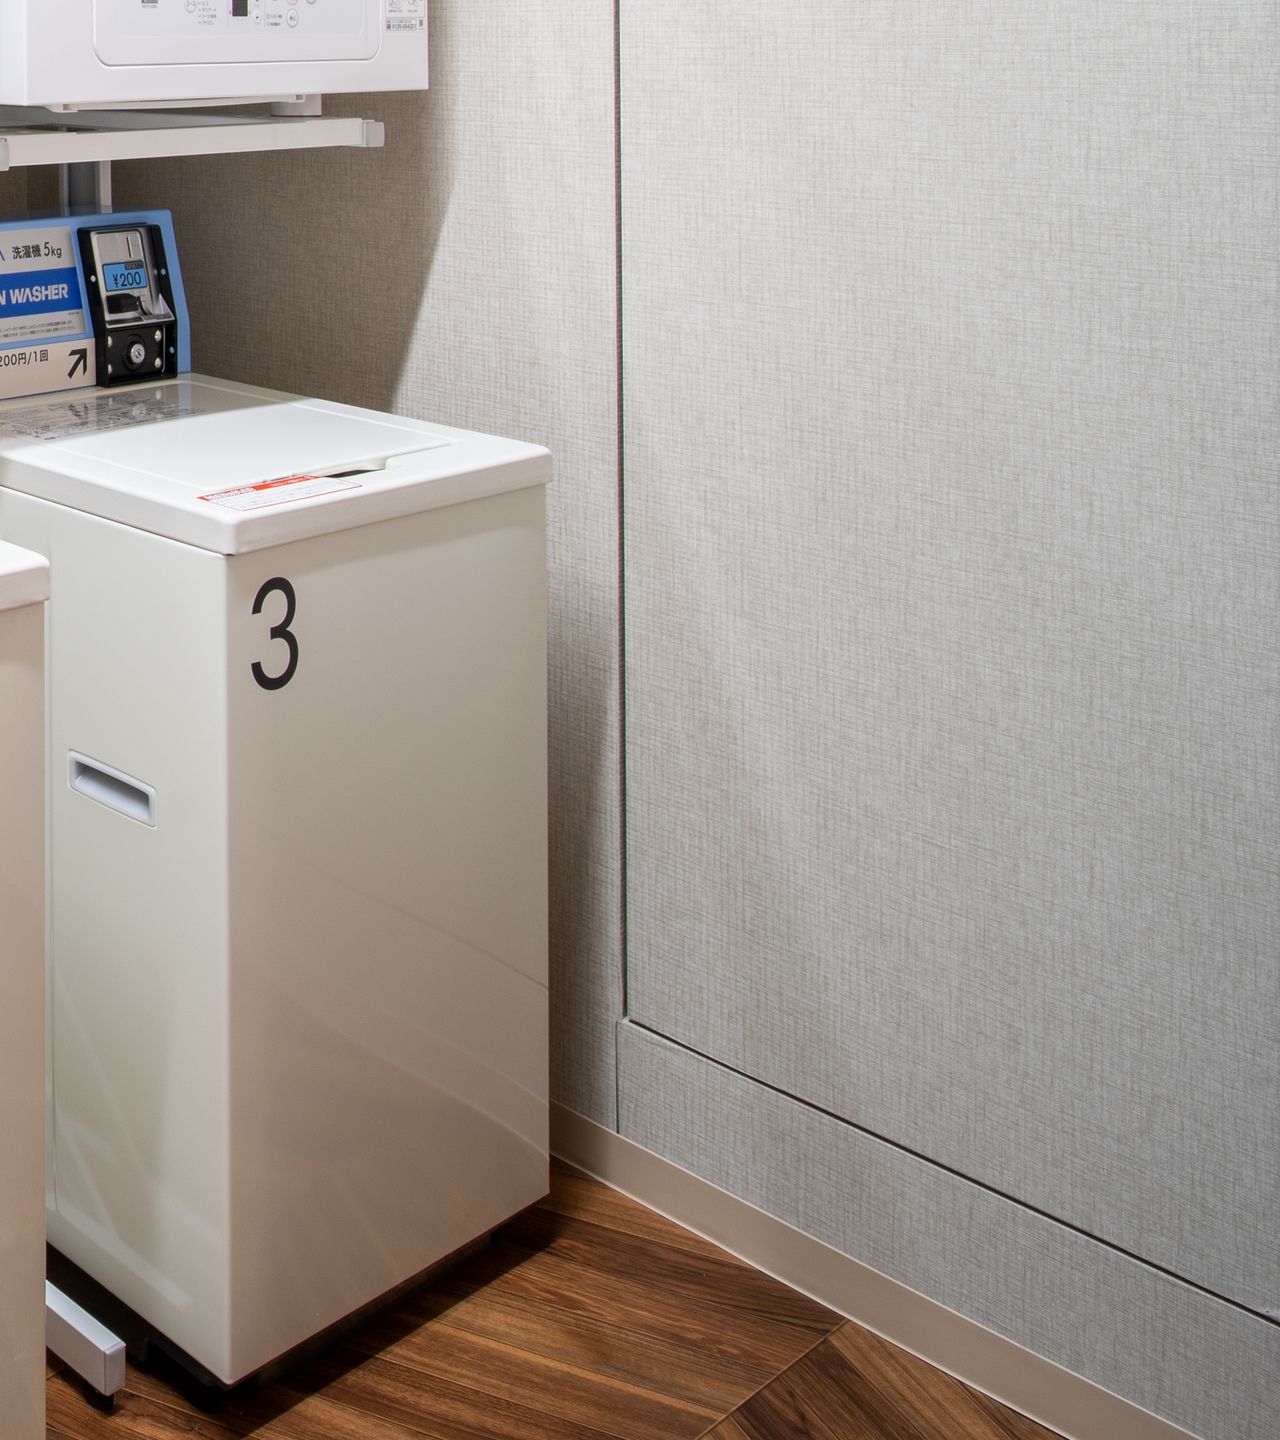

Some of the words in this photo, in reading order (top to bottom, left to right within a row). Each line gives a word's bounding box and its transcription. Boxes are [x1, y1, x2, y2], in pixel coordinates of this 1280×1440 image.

[12, 244, 41, 259] 洗濯機
[44, 242, 62, 258] 5kg
[113, 272, 141, 288] ¥200
[10, 284, 68, 304] WASHER
[250, 576, 299, 690] 3
